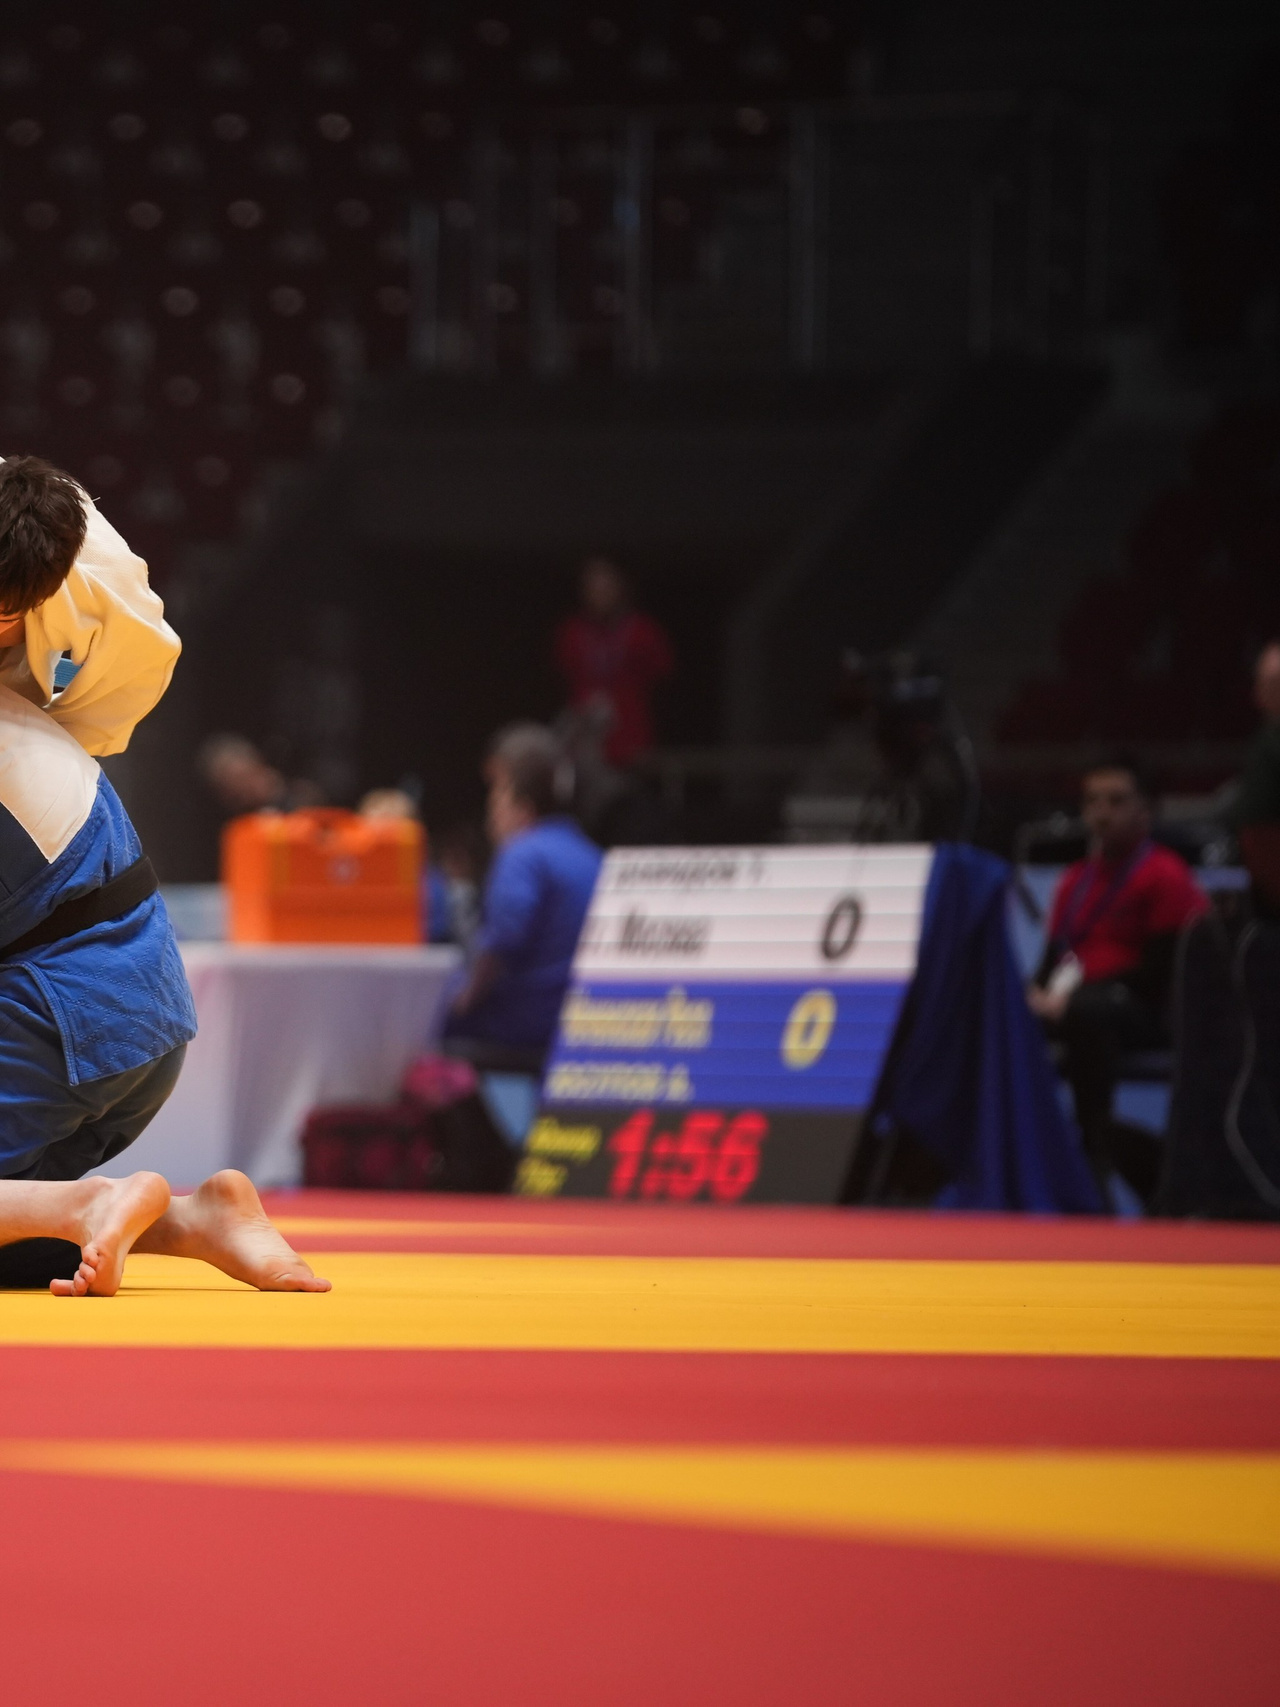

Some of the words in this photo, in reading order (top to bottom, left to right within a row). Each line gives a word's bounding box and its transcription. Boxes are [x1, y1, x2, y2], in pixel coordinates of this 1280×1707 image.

[819, 893, 863, 961] 0
[781, 989, 837, 1071] 0
[609, 1109, 769, 1203] 1:56
